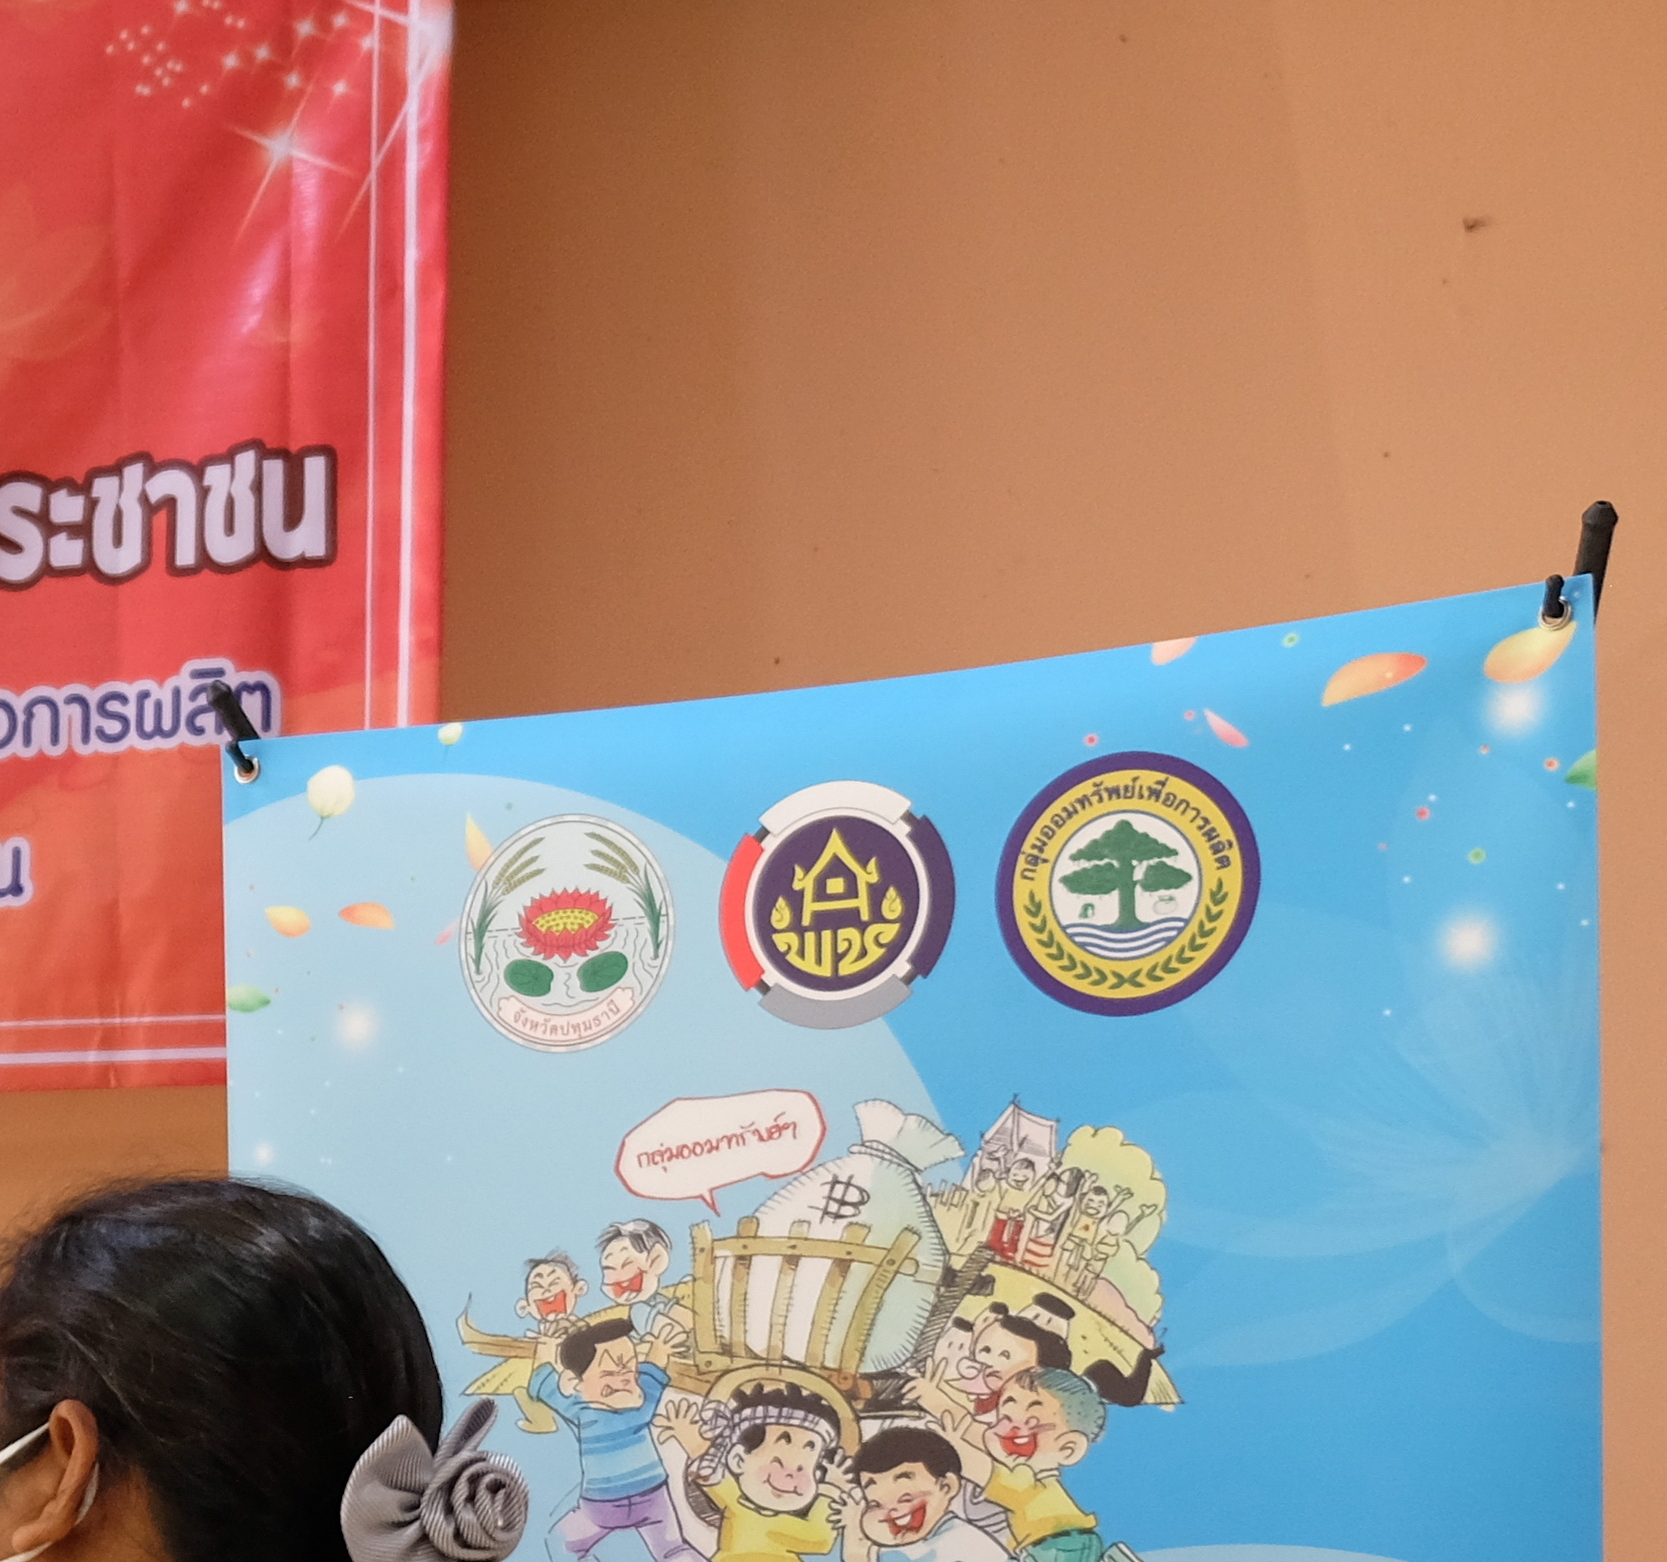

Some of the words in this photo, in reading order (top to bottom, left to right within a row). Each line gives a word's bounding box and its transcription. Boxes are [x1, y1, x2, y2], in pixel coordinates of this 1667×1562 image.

[1020, 775, 1234, 882] กลุ่มออมทรัพย์เพื่อการผลิต
[513, 999, 621, 1040] จังหวัดปทุมธานี
